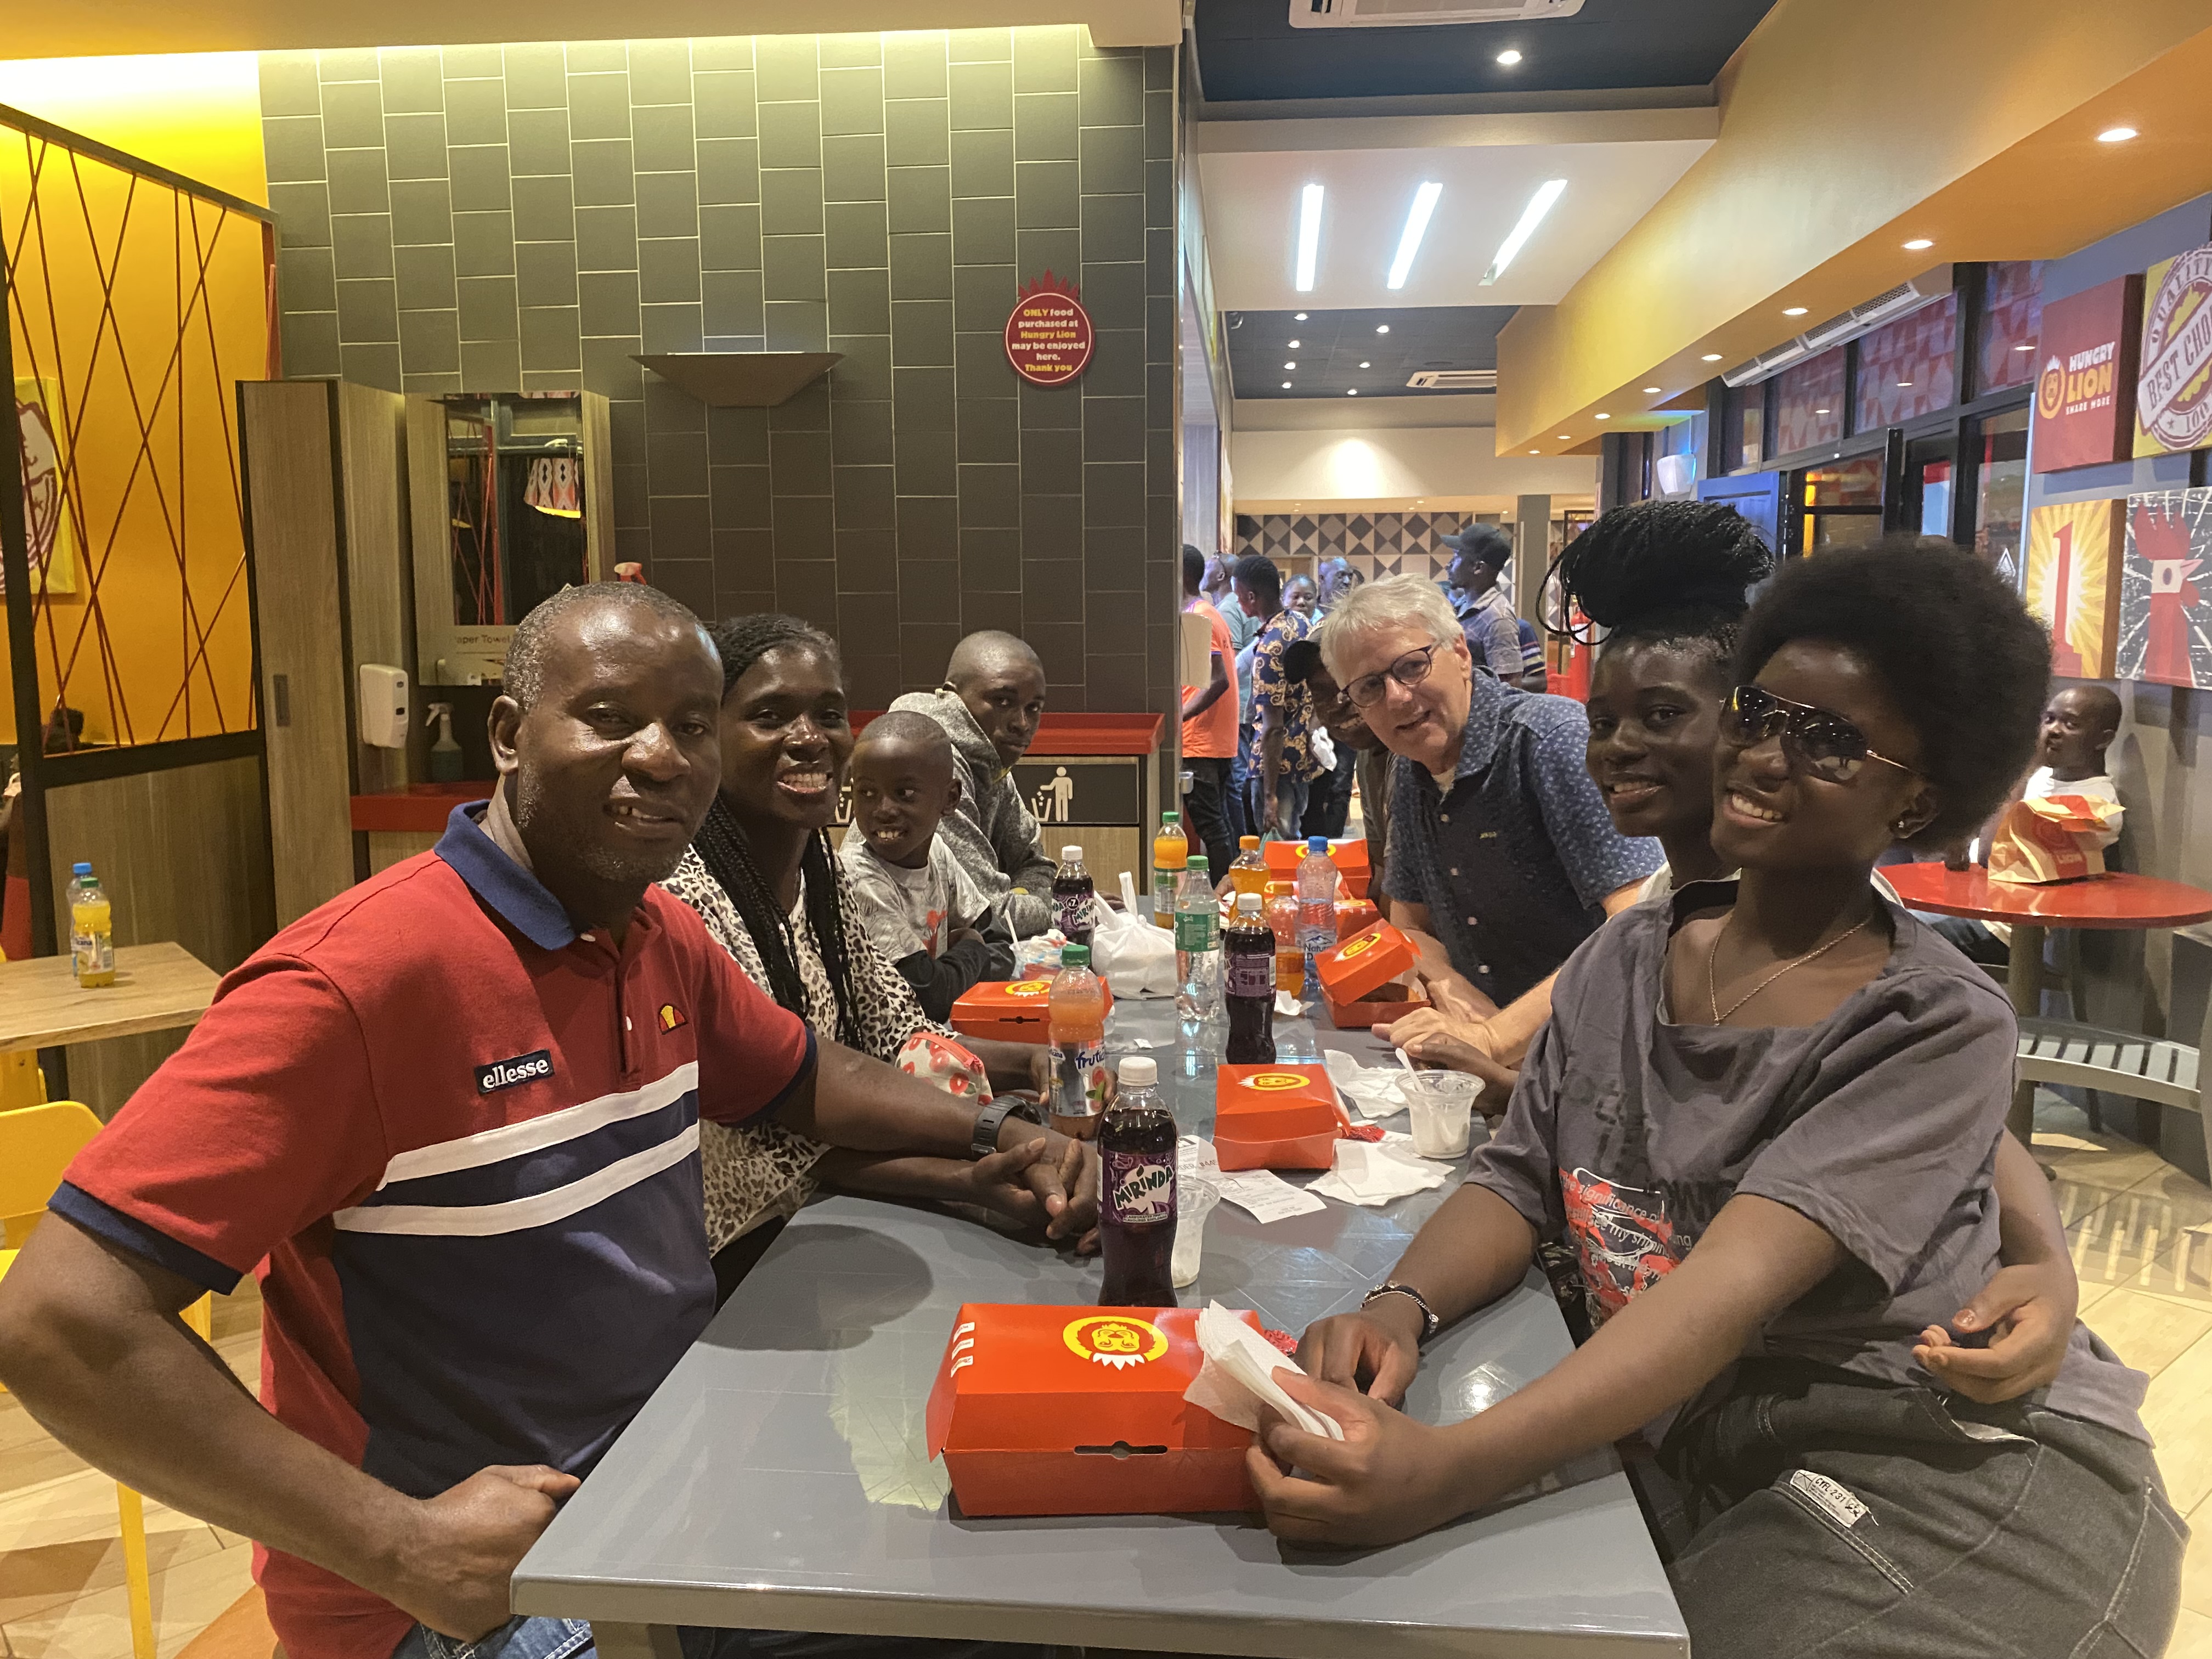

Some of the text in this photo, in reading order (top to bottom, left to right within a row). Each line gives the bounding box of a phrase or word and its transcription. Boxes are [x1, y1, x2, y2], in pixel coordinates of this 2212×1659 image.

[1018, 320, 1067, 329] purchased
[1021, 331, 1055, 339] Hungry
[1047, 342, 1086, 350] enjoyed
[2069, 341, 2115, 373] HUNGRY
[1025, 364, 1053, 372] Thank
[2067, 362, 2113, 404] LION
[2147, 349, 2180, 410] BEST
[2066, 396, 2111, 415] SHARE MORE
[482, 634, 510, 644] Towel
[1304, 943, 1327, 952] Natur
[483, 1059, 549, 1088] ellesse
[1113, 1164, 1174, 1210] MIRINDA
[1578, 1184, 1647, 1218] significance
